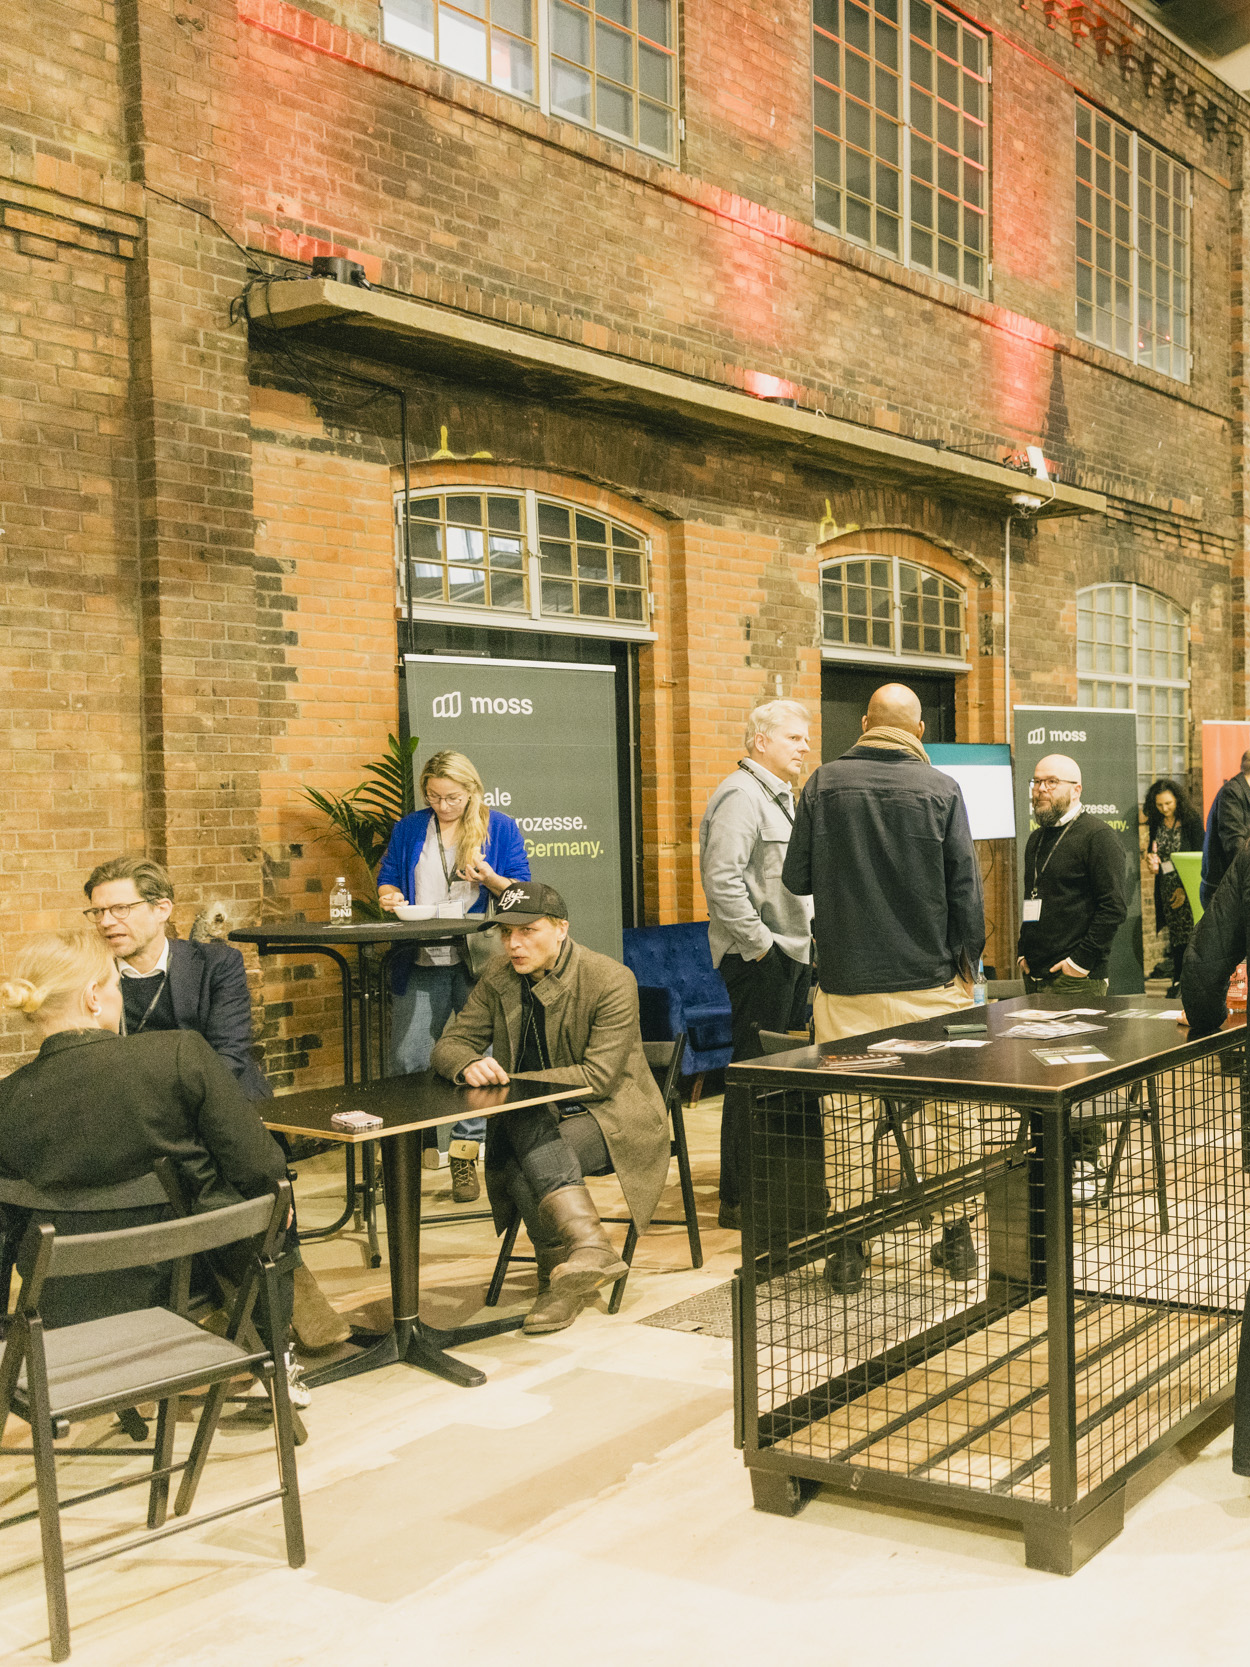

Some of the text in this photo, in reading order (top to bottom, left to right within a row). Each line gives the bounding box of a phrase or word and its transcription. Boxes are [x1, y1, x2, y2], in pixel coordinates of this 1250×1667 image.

[470, 696, 533, 715] moss
[1049, 729, 1087, 743] moss
[483, 787, 512, 807] ale
[514, 816, 588, 832] rozesse.
[523, 838, 604, 858] Germany.
